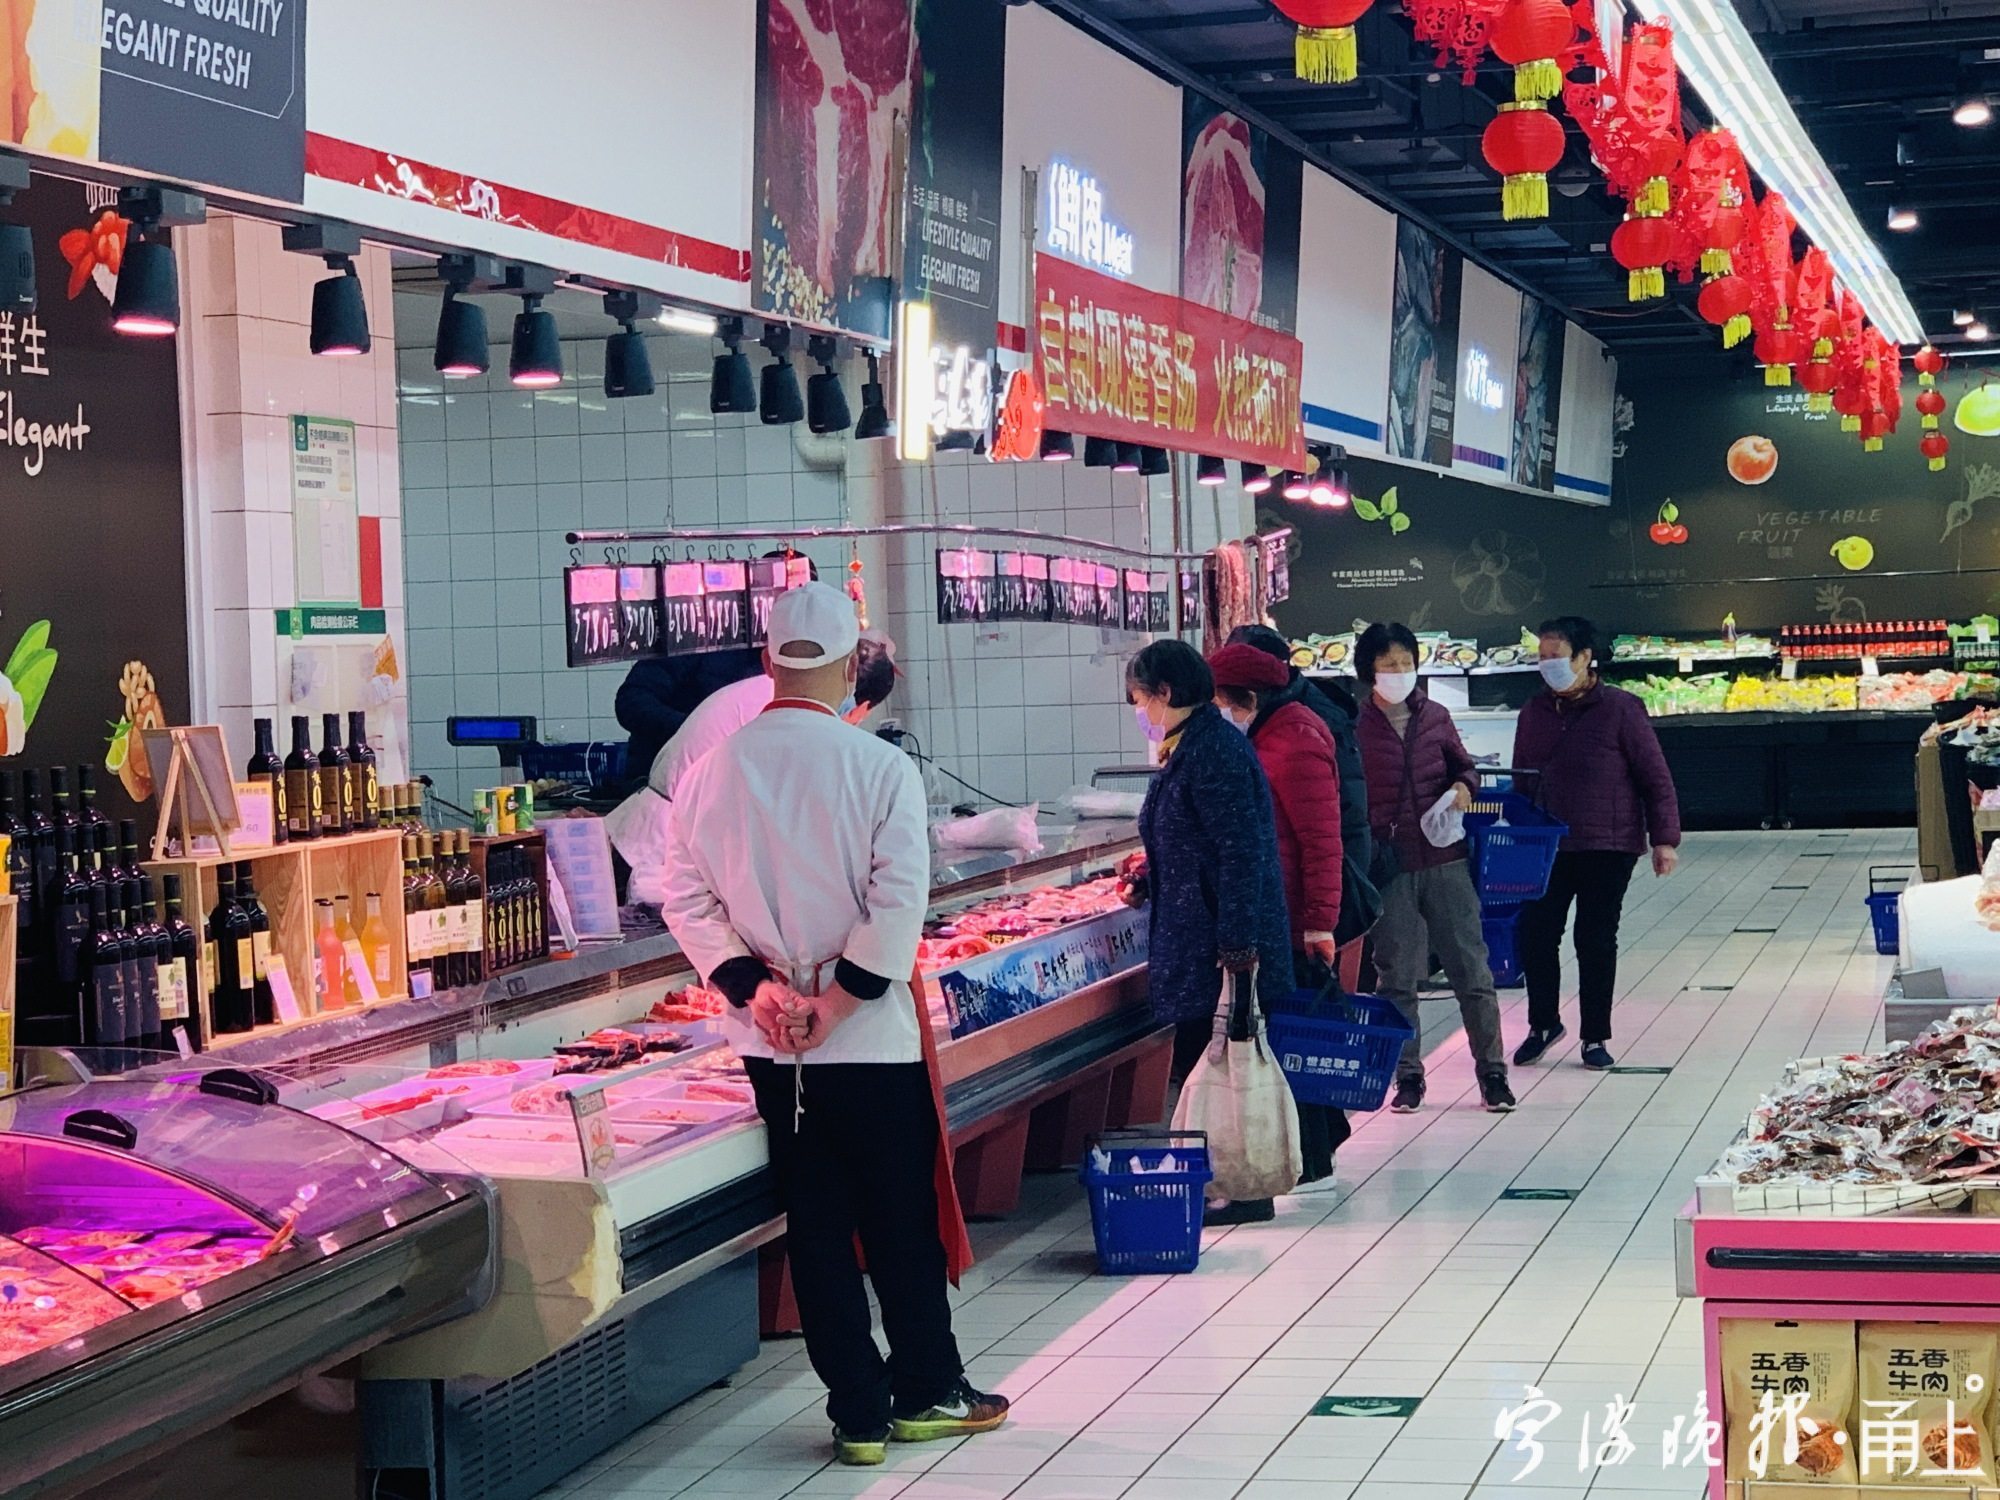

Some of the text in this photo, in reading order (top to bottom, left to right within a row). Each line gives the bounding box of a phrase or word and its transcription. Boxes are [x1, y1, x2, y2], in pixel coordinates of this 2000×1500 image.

[183, 33, 251, 90] FRESH
[922, 217, 992, 261] LIFESTYLE QUALITY
[921, 254, 981, 294] ELEGANT FRESH
[1040, 288, 1197, 433] 自制现灌香肠
[1757, 508, 1883, 526] VEGETABLE
[1737, 528, 1803, 545] FRUIT
[1306, 1056, 1360, 1070] 世纪联华
[1750, 1352, 1810, 1372] 五香
[1888, 1348, 1950, 1368] 五香
[1750, 1374, 1809, 1394] 牛肉
[1888, 1370, 1949, 1392] 牛肉
